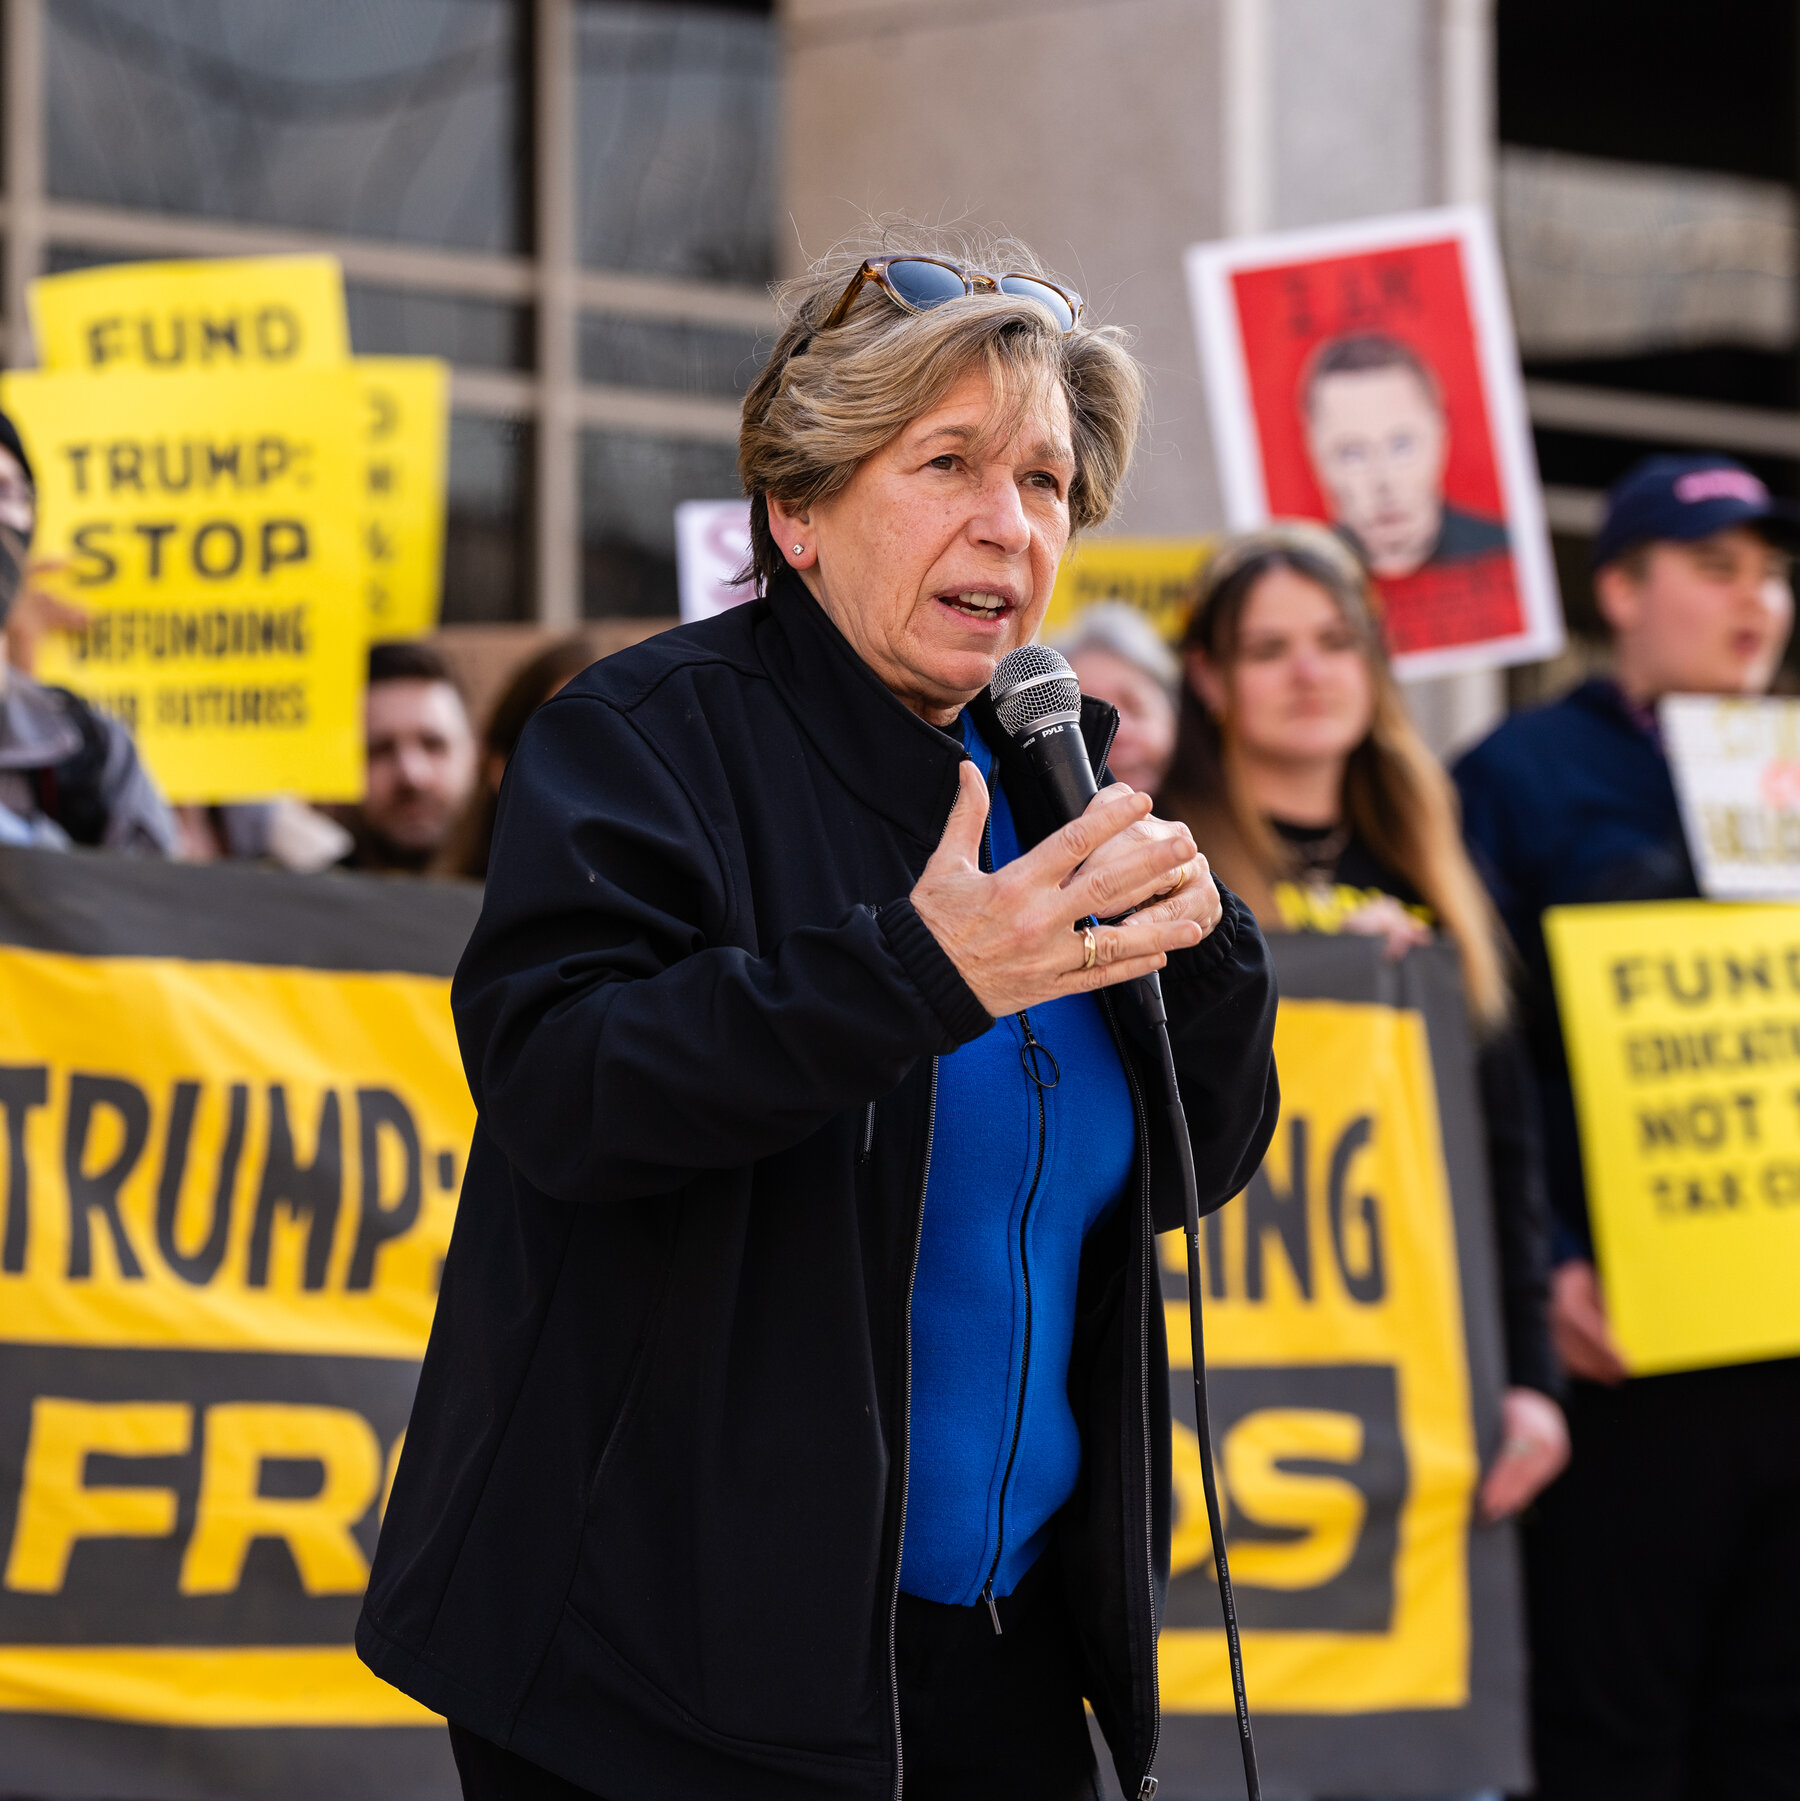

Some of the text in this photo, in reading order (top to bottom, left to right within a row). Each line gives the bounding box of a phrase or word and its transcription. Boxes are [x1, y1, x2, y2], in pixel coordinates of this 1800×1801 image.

[86, 305, 301, 370] FUND
[62, 440, 311, 496] TRUMP:
[70, 519, 312, 587] STOP
[1041, 725, 1065, 738] PYLE
[1640, 1092, 1760, 1156] NOT
[0, 1063, 456, 1294] TRUMP:
[1650, 1169, 1747, 1220] TAX
[5, 1398, 409, 1596] FR
[1224, 1581, 1234, 1620] Microphone
[1231, 1625, 1239, 1654] Premium
[1234, 1657, 1243, 1693] ADVANTAGE
[1239, 1696, 1247, 1718] WIRE
[1242, 1718, 1250, 1738] LIVE
